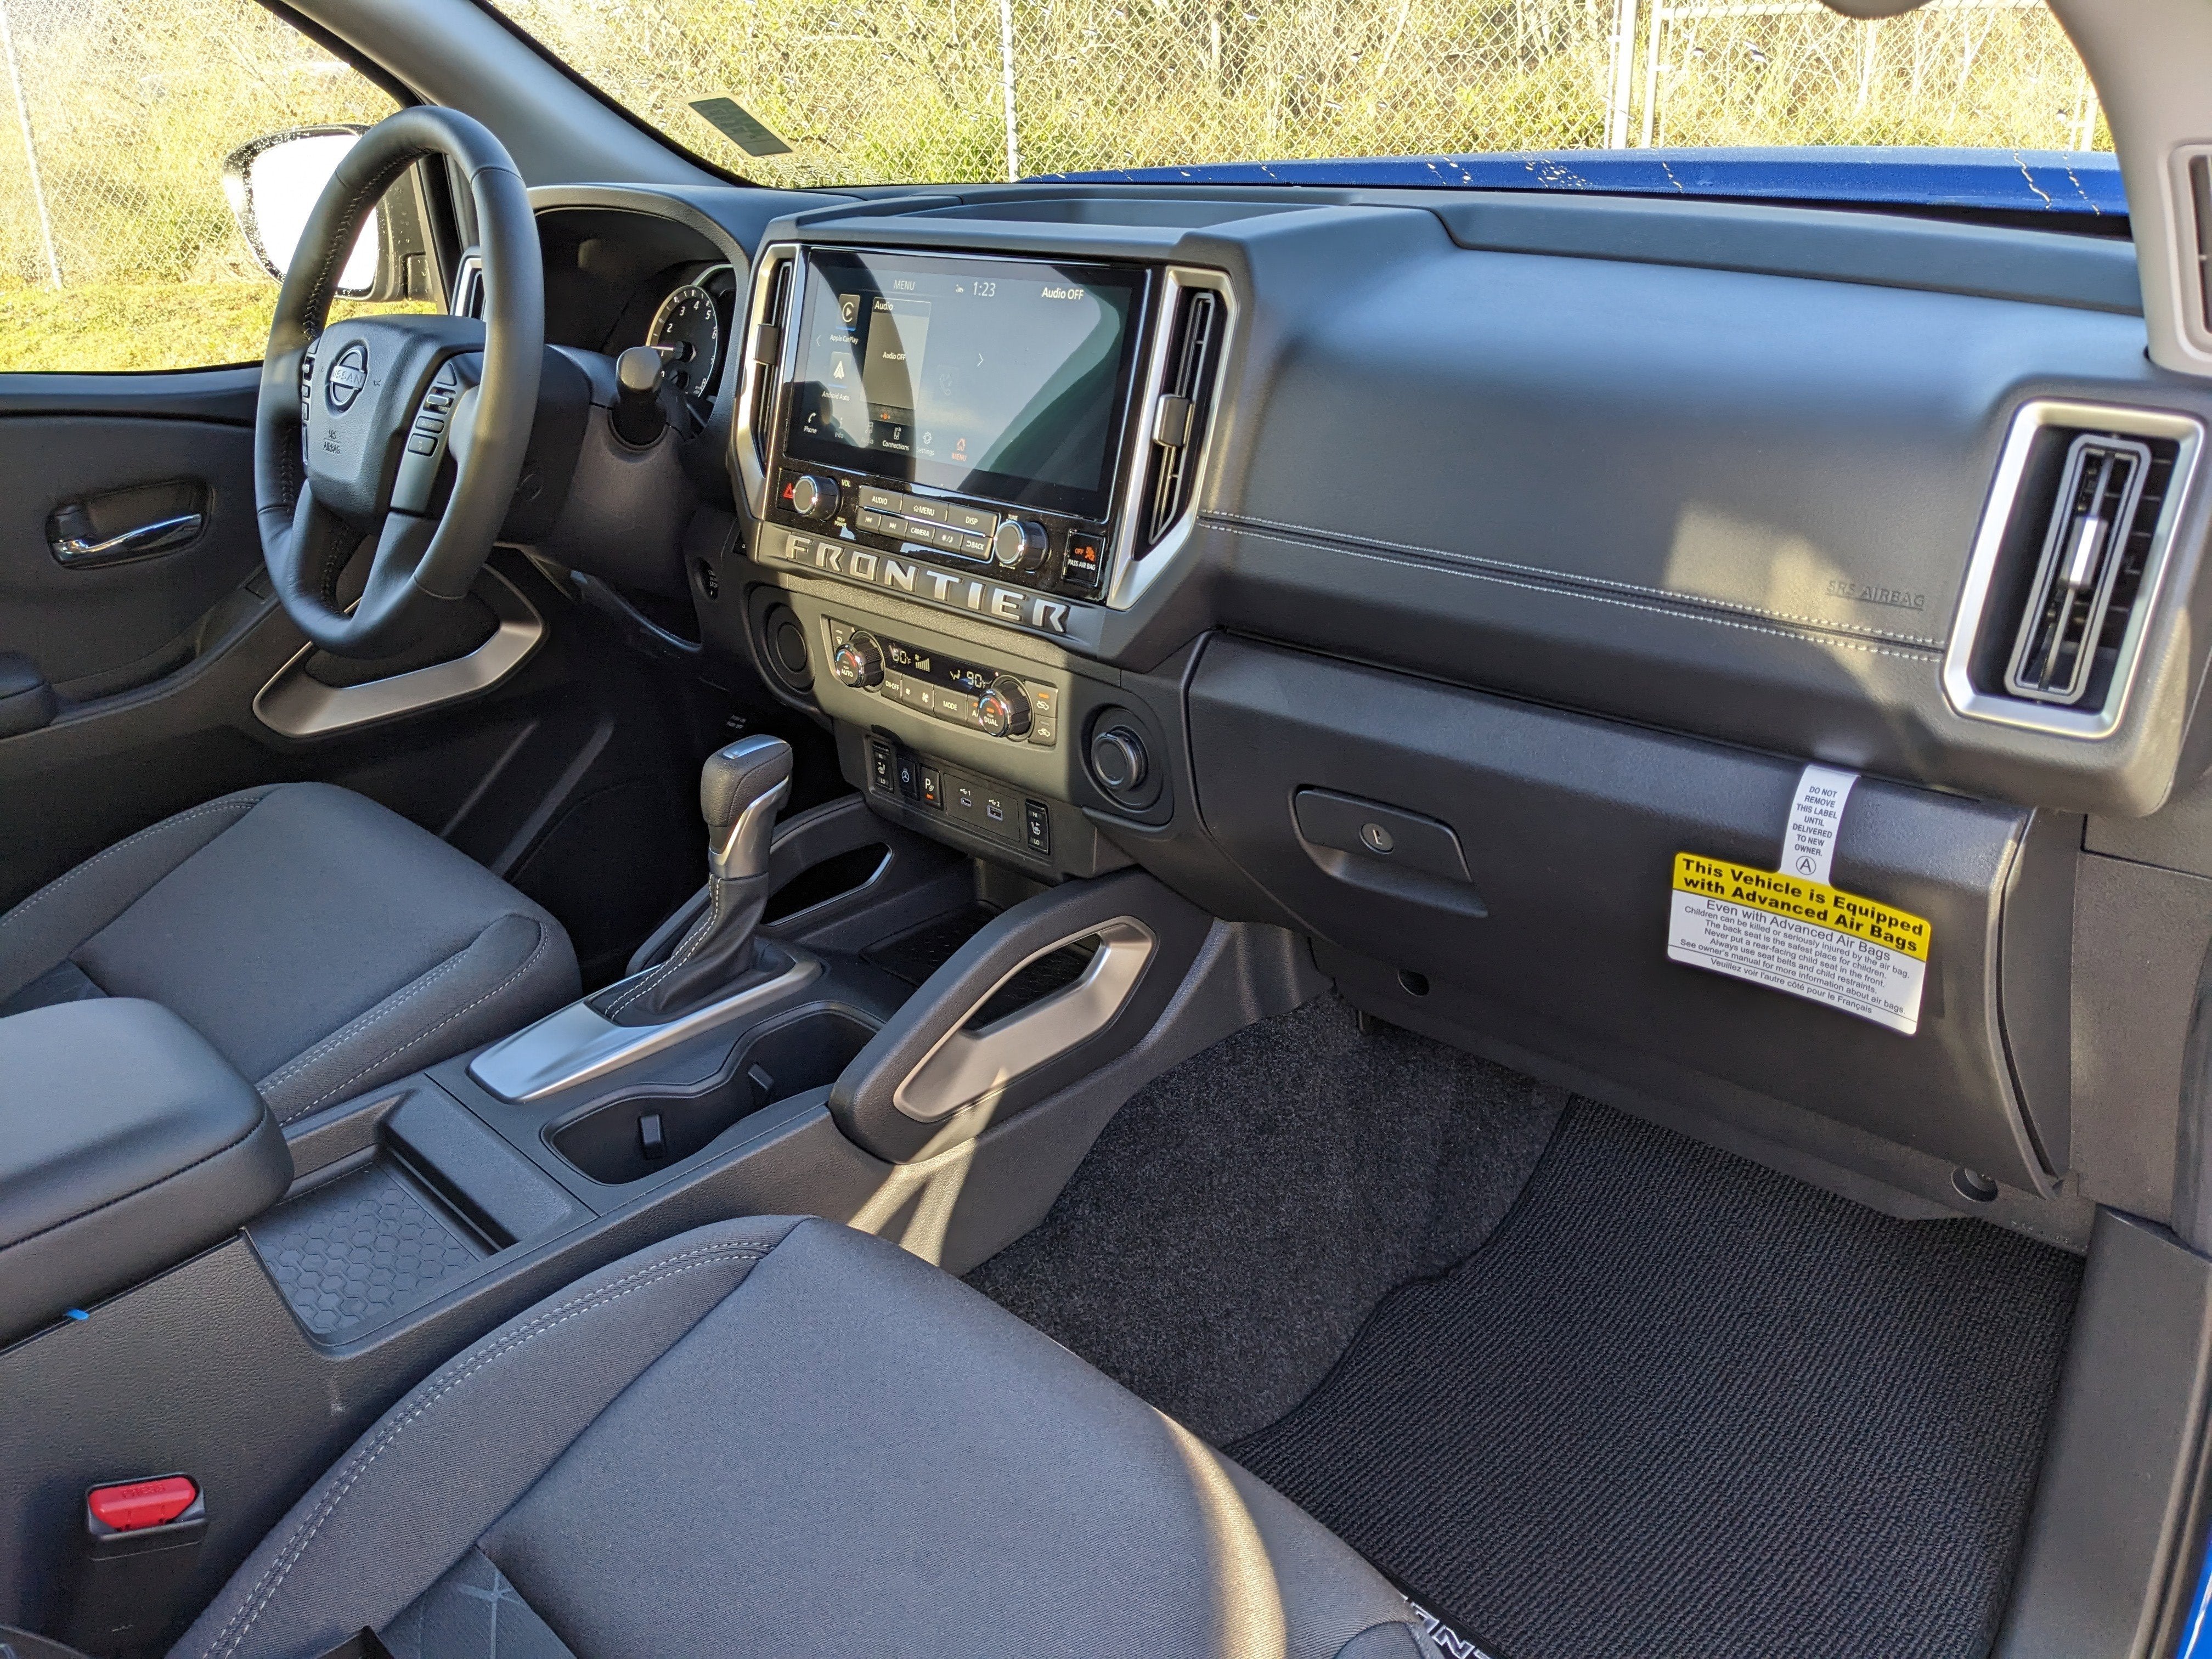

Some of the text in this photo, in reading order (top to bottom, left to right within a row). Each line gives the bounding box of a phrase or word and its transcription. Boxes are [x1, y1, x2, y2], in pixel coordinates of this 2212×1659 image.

[894, 280, 915, 290] MENU
[973, 281, 996, 297] 1:23
[1041, 287, 1085, 300] Audio OFF
[679, 306, 685, 316] 3
[693, 301, 699, 311] 4
[874, 301, 893, 311] Audio
[706, 310, 712, 320] 5
[667, 323, 673, 332] 2
[830, 334, 859, 345] Apple CarPlay
[883, 352, 896, 360] Audio
[822, 391, 850, 401] Android Auto
[804, 425, 817, 434] Phone
[882, 439, 909, 452] Connections
[916, 446, 934, 456] Settings
[952, 453, 967, 461] MENU
[842, 479, 851, 487] VOL
[872, 495, 888, 505] AUDIO
[919, 506, 935, 516] MENU
[965, 516, 979, 526] DISP
[910, 527, 930, 538] CAMERA
[970, 541, 984, 551] BACK
[1068, 558, 1079, 567] PASS
[786, 534, 1070, 633] FRONTIER
[1860, 585, 1926, 608] AIRBAG
[841, 669, 854, 678] AUTO
[943, 700, 957, 711] MODE
[984, 715, 998, 726] DUAL
[1809, 786, 1837, 798] DO NOT
[1804, 795, 1836, 808] REMOVE
[1797, 803, 1837, 819] THIS LABEL
[1804, 815, 1824, 827] UNTIL
[1792, 823, 1832, 838] DELIVERED
[1797, 834, 1825, 847] TO NEW
[1795, 843, 1822, 856] OWNER.
[1799, 858, 1812, 872] A
[1682, 858, 1923, 937] This Vehicle is Equipped
[1684, 877, 1917, 952] with Advanced Air Bags
[1707, 899, 1890, 961] Even with Advanced Air Bags
[1684, 906, 1718, 919] Children
[1720, 916, 1735, 924] can
[1737, 918, 1747, 927] be
[1750, 922, 1770, 933] killed
[1783, 933, 1820, 949] seriously
[1822, 942, 1850, 956] injured
[1852, 951, 1863, 962] by
[1864, 956, 1877, 966] the
[1892, 966, 1910, 979] bag.
[1705, 919, 1720, 929] The
[1723, 924, 1742, 935] back
[1744, 930, 1762, 940] seat
[1773, 937, 1786, 946] the
[1788, 943, 1813, 954] safest
[1814, 950, 1837, 961] place
[1839, 956, 1851, 966] for
[1852, 962, 1887, 979] children.
[1704, 928, 1729, 939] Never
[1730, 935, 1743, 944] put
[1753, 941, 1796, 960] rear-facing
[1798, 954, 1818, 964] child
[1820, 961, 1838, 971] seat
[1839, 966, 1847, 974] in
[1849, 969, 1863, 979] the
[1865, 974, 1885, 988] front.
[1710, 938, 1877, 994] Always use seat belts and child restraints.
[1680, 939, 1696, 948] See
[1698, 944, 1729, 957] owner's
[1731, 953, 1760, 966] manual
[1763, 961, 1774, 969] for
[1775, 966, 1796, 976] more
[1798, 971, 1844, 991] information
[1846, 988, 1869, 1000] about
[1884, 1000, 1906, 1014] bags.
[1711, 957, 1742, 972] Veuillez
[1760, 971, 1785, 984] l'autre
[1787, 981, 1804, 991] côté
[1807, 986, 1826, 997] pour
[1827, 992, 1835, 1000] le
[1837, 995, 1872, 1013] Français
